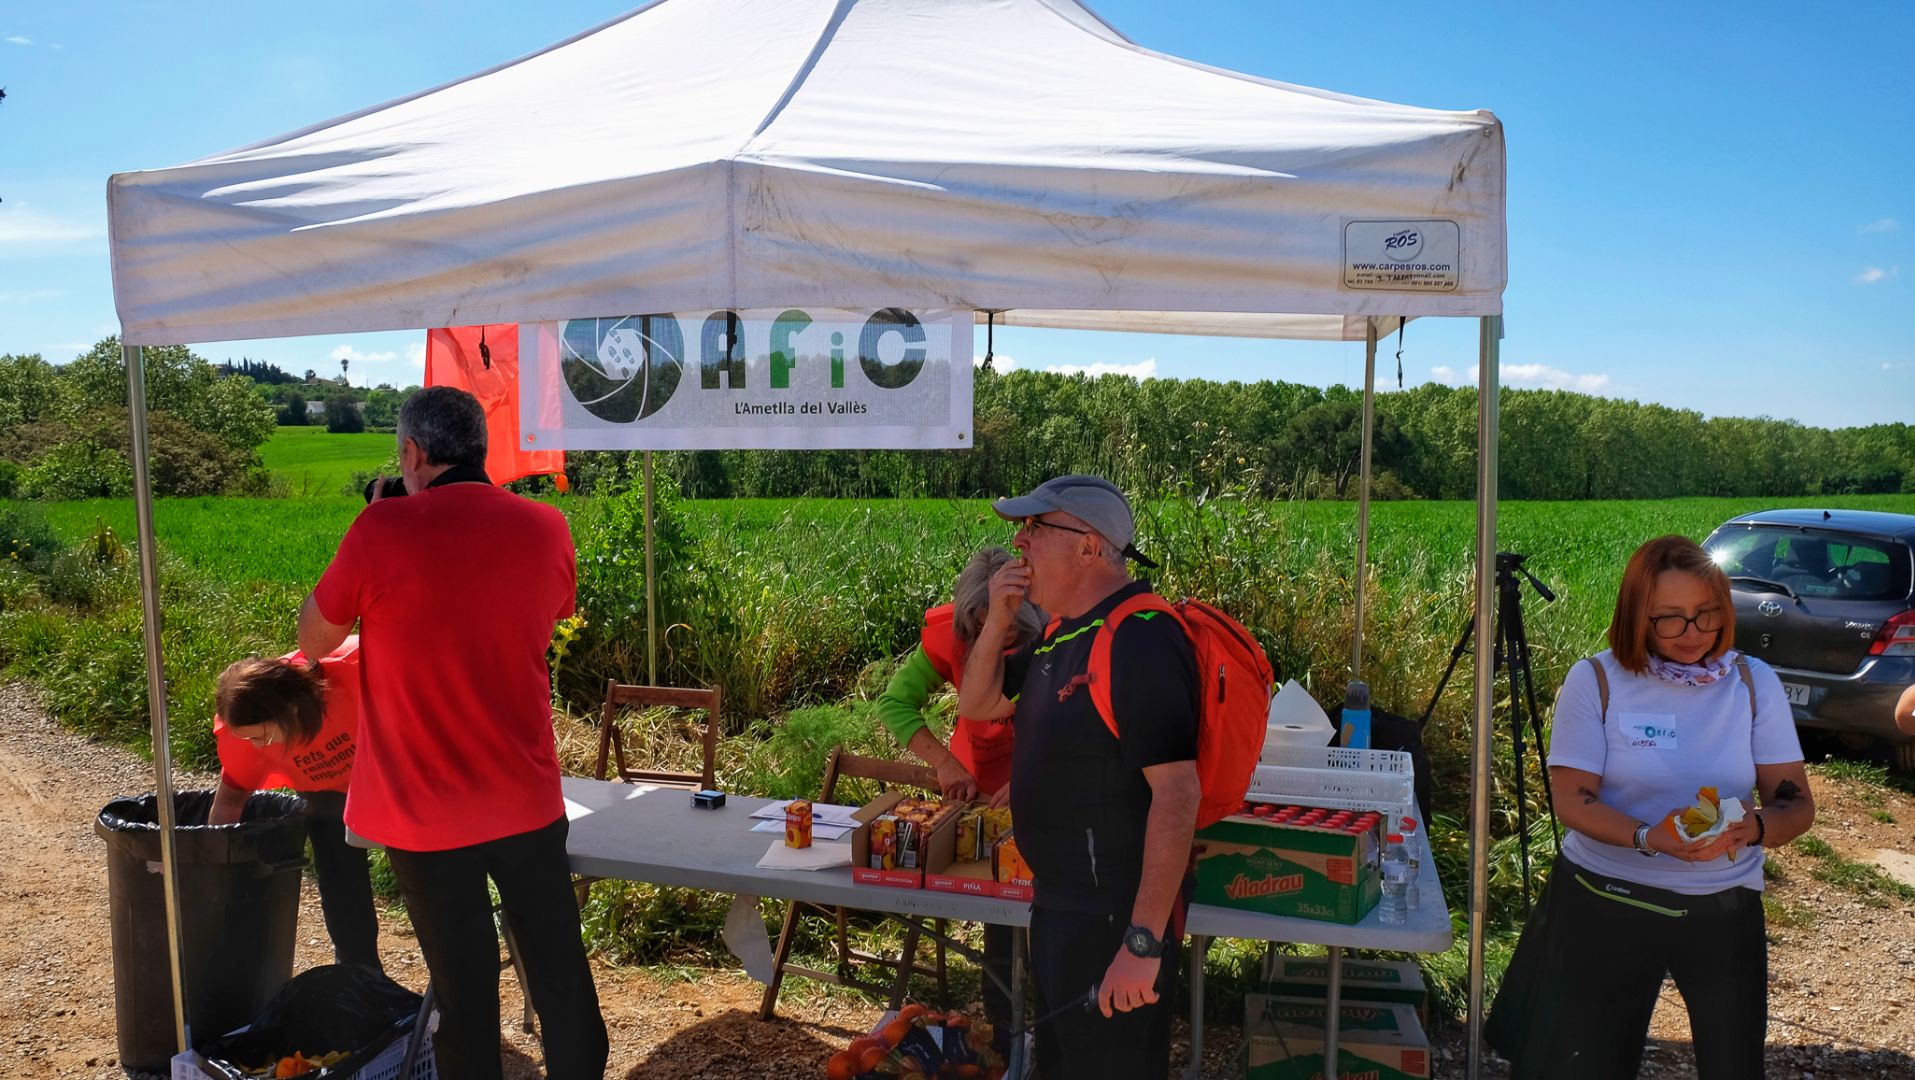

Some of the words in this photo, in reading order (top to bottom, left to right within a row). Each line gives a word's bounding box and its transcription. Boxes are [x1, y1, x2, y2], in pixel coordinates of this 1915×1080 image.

[1385, 232, 1418, 250] ROS
[1353, 263, 1451, 272] www.carpesros.com
[735, 401, 795, 415] L'Ametlla
[800, 401, 822, 415] del
[827, 400, 868, 415] Vallès
[294, 751, 325, 767] Fets
[326, 732, 350, 751] que
[963, 882, 981, 891] PIÑA
[1225, 873, 1304, 899] Viladrau
